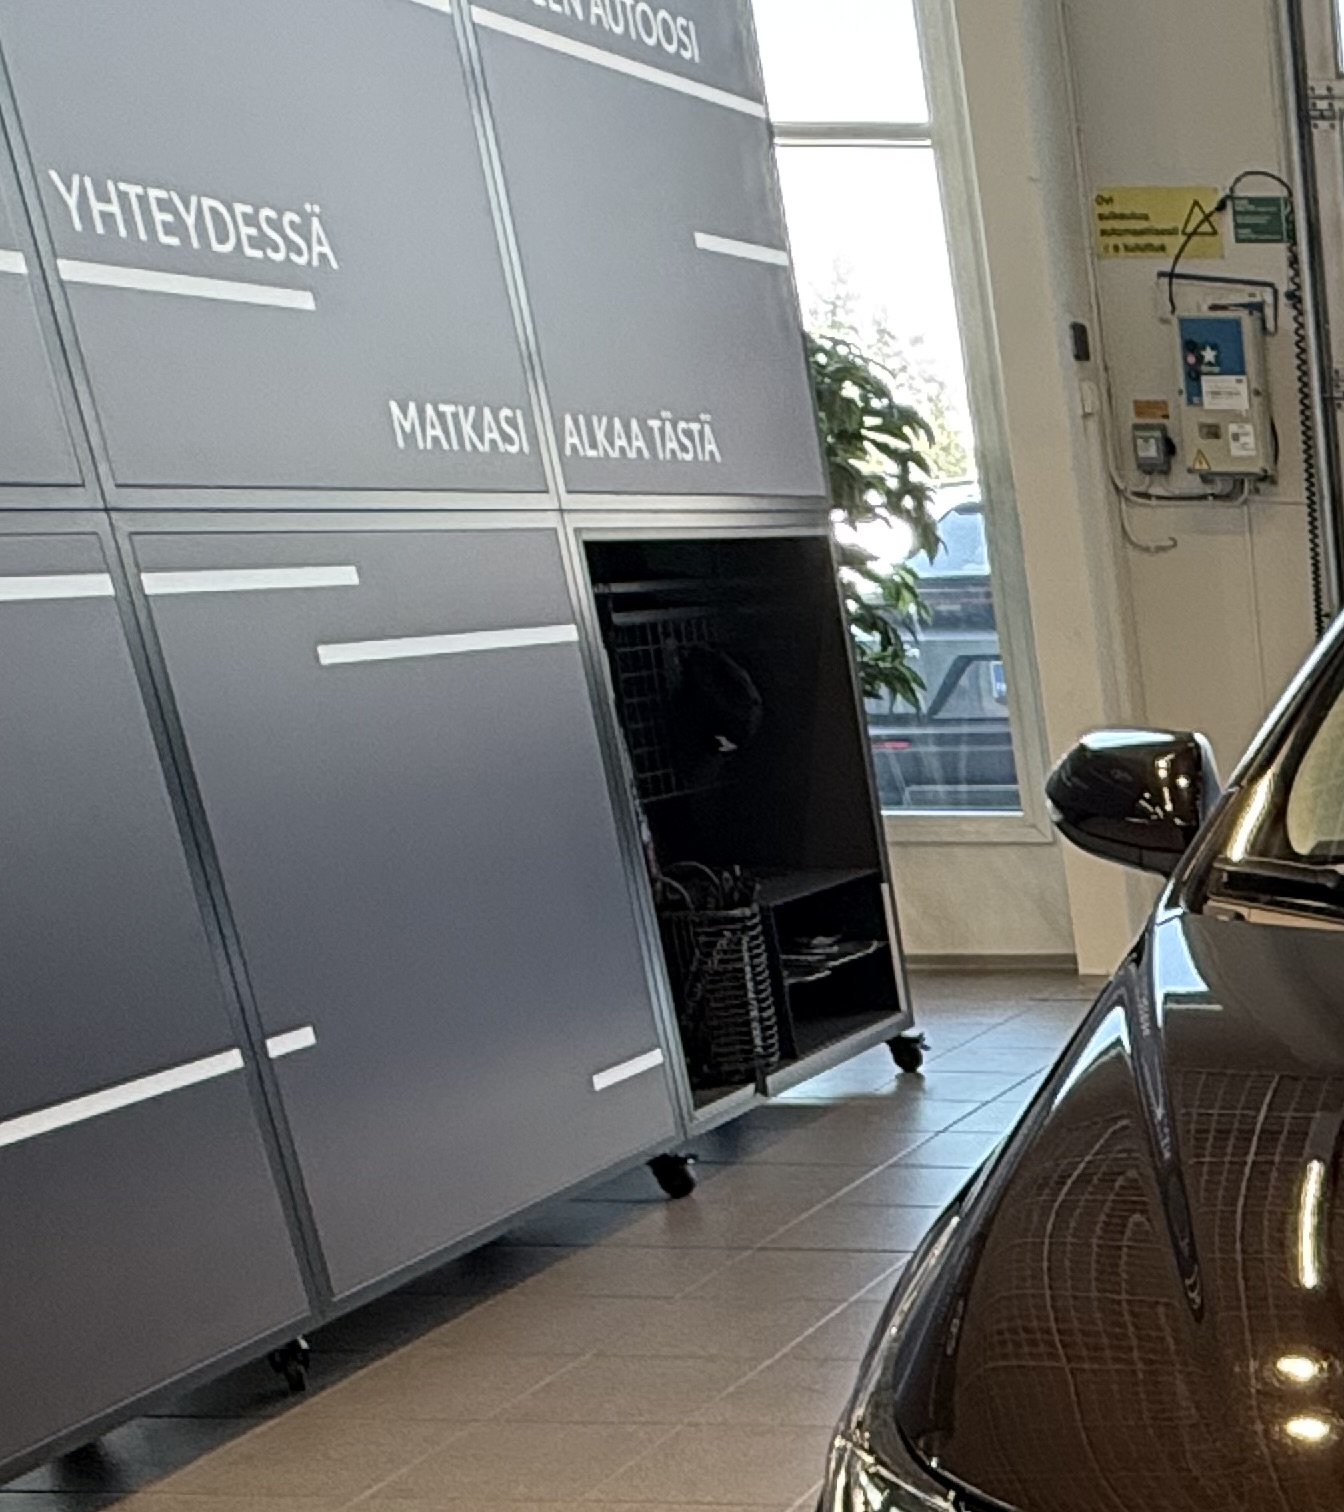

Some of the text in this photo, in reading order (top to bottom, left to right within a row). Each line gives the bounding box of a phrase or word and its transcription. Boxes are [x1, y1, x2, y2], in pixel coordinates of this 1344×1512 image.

[590, 0, 700, 64] AUTOOSI
[49, 169, 339, 269] YHTEYDESSÄ
[388, 400, 722, 463] MATKASI ALKAA TÄSTÄ
